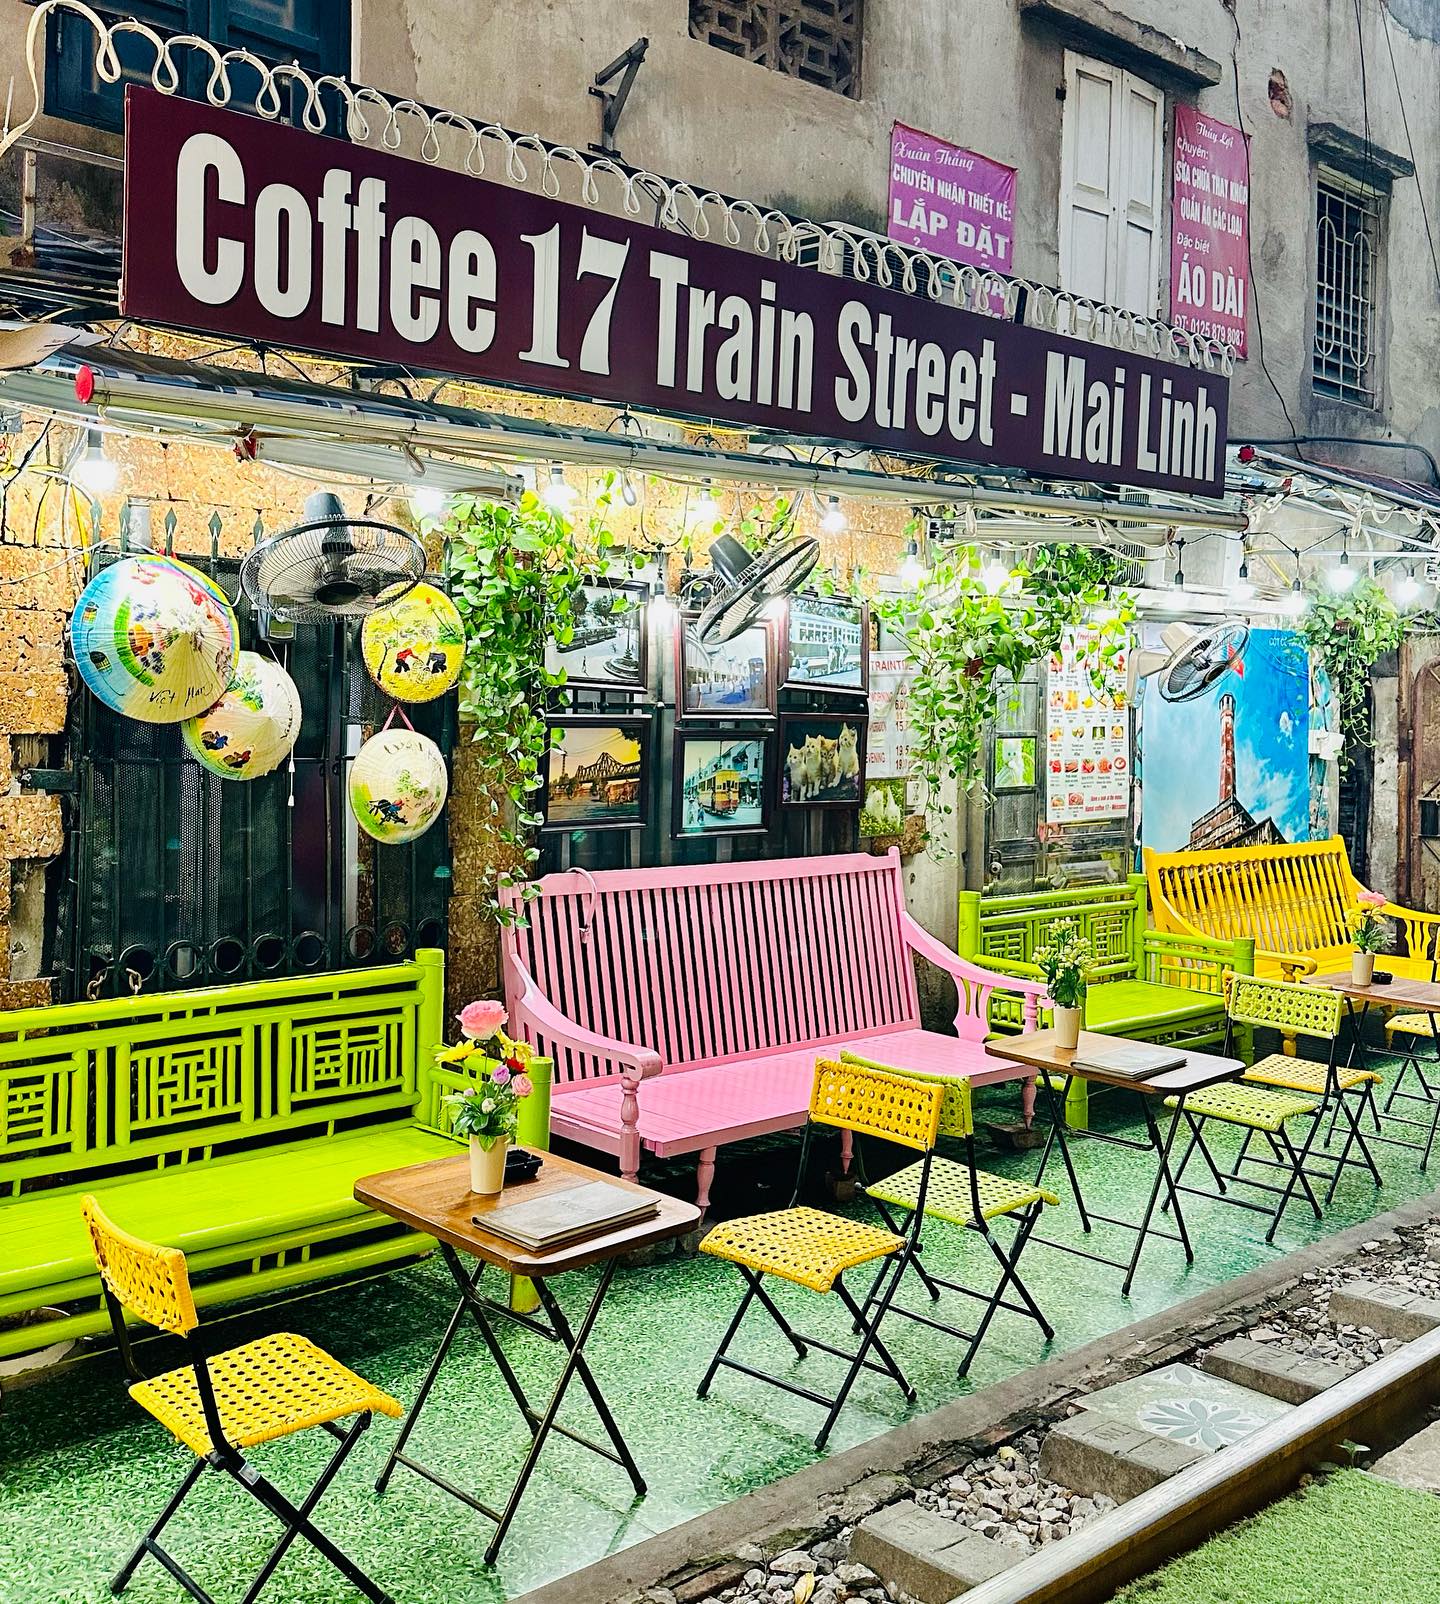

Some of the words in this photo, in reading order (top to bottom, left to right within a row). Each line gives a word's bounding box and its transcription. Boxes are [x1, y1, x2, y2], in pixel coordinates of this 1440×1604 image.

[894, 141, 932, 162] Xuân
[892, 163, 935, 194] CHUYÊN
[937, 179, 966, 206] NHẬN
[967, 191, 994, 215] THIẾT
[1212, 174, 1229, 199] THAY
[893, 197, 949, 236] LẮP
[956, 221, 1010, 259] ĐẶT
[1194, 237, 1210, 255] biệt
[176, 132, 497, 355] Coffee
[518, 222, 631, 376] 17
[650, 250, 814, 413] Train
[834, 300, 997, 447] Street
[1010, 393, 1028, 416] -
[1042, 350, 1126, 466] Mai
[1136, 373, 1217, 482] Linh
[1177, 253, 1206, 308] ÁO
[1212, 265, 1244, 318] DÀI
